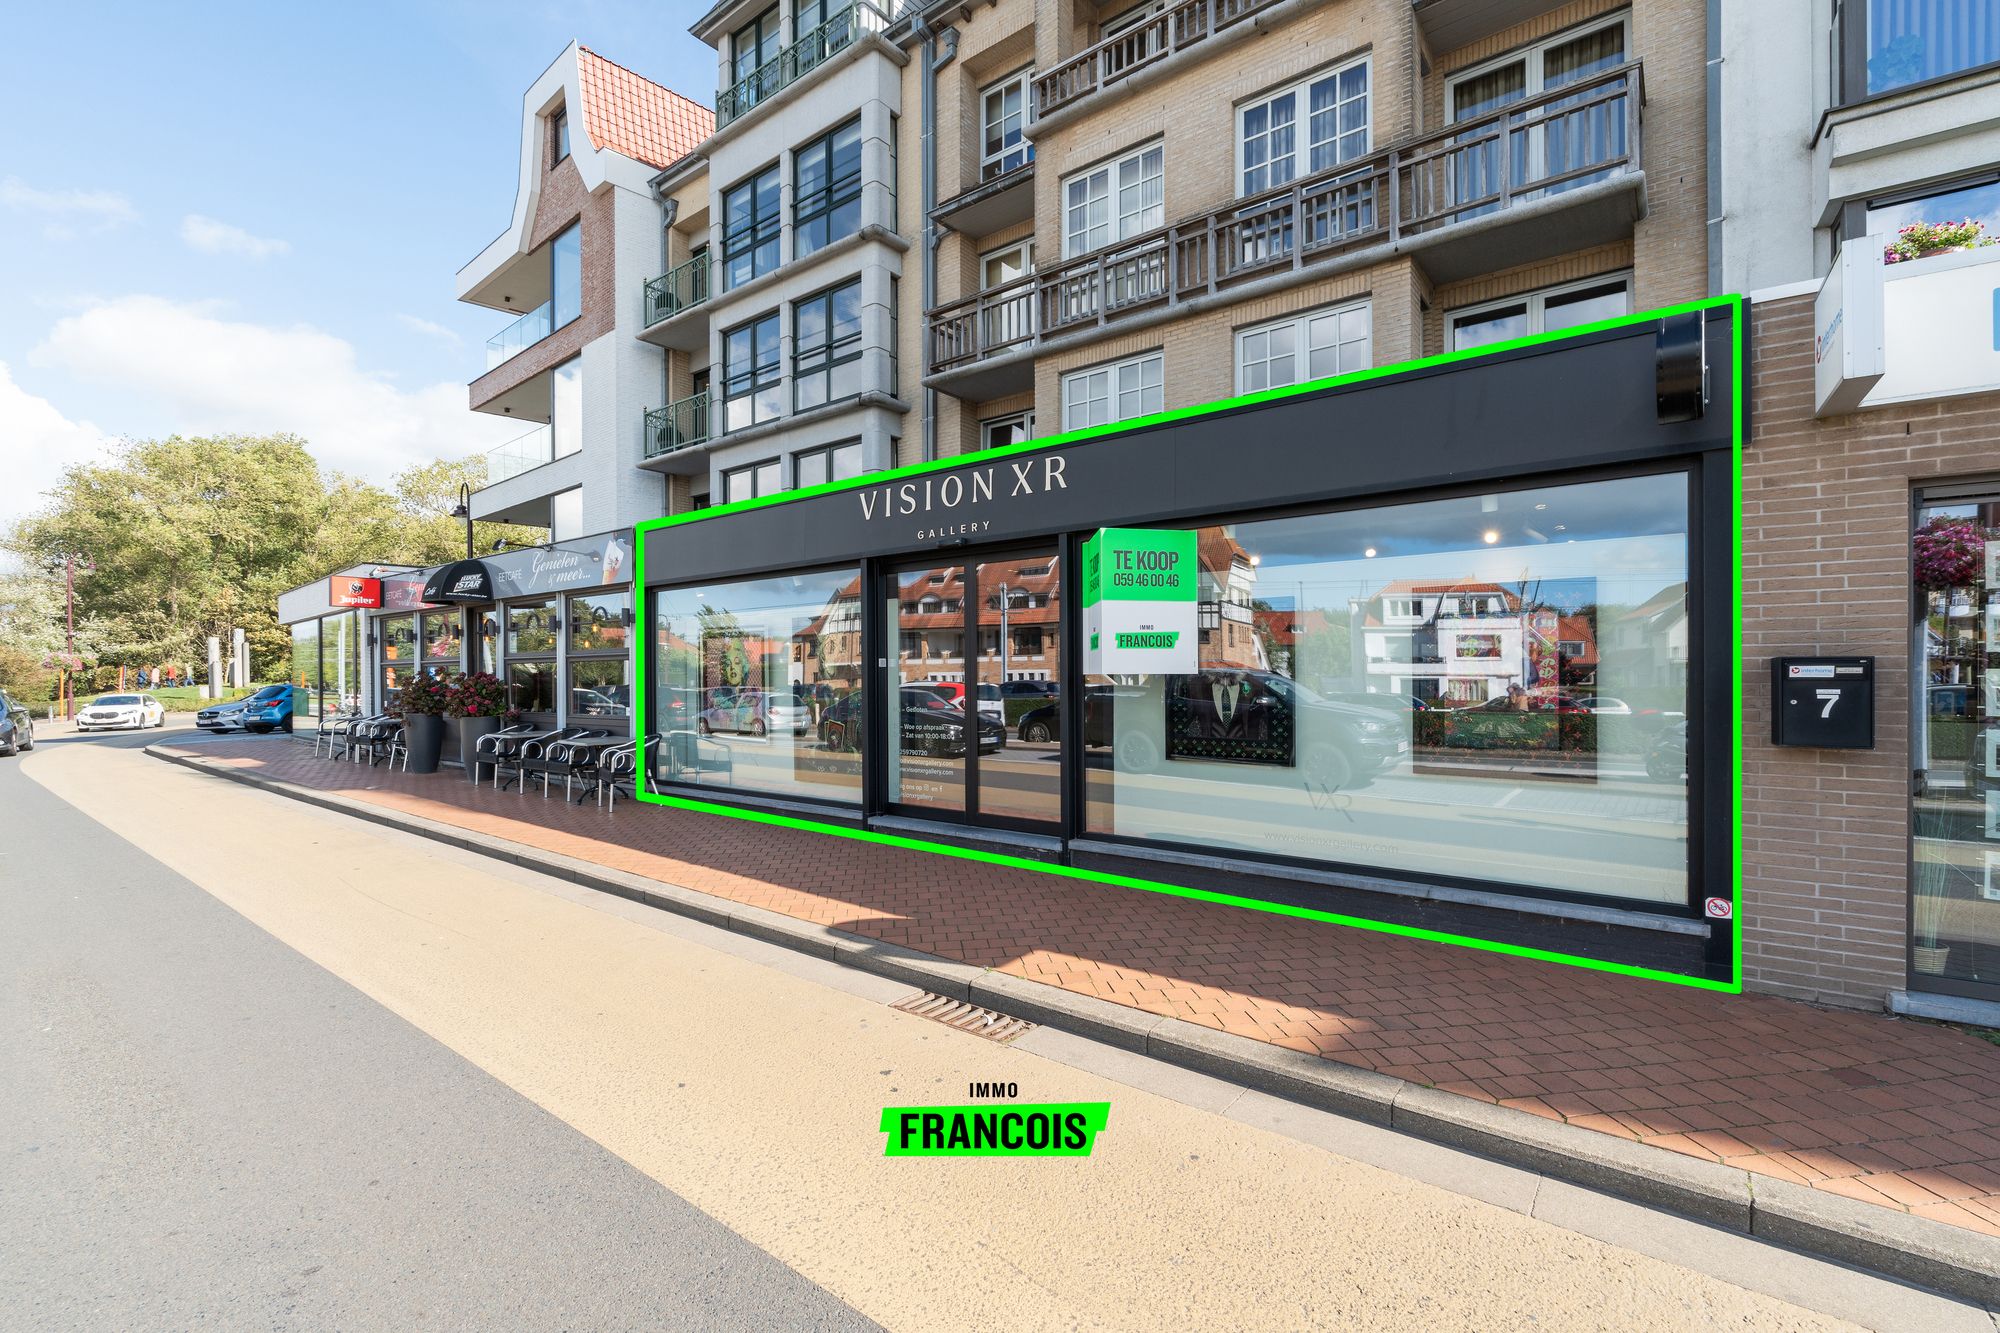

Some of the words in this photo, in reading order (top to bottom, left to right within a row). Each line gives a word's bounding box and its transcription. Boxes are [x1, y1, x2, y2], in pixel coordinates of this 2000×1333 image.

[858, 468, 994, 521] VISION
[1010, 455, 1068, 497] XR
[917, 520, 990, 540] GALLERY
[1113, 549, 1133, 570] TE
[1136, 550, 1179, 571] KOOP
[556, 568, 591, 583] meer...
[1113, 573, 1134, 587] 059
[1136, 573, 1149, 587] 46
[1150, 573, 1164, 587] 00
[1166, 574, 1180, 587] 46
[457, 580, 481, 589] STAR
[339, 594, 375, 605] Jupiler
[1119, 634, 1173, 648] FRANCOIS
[1816, 694, 1840, 718] 7
[1264, 831, 1399, 855] www.visionxrgallery.com
